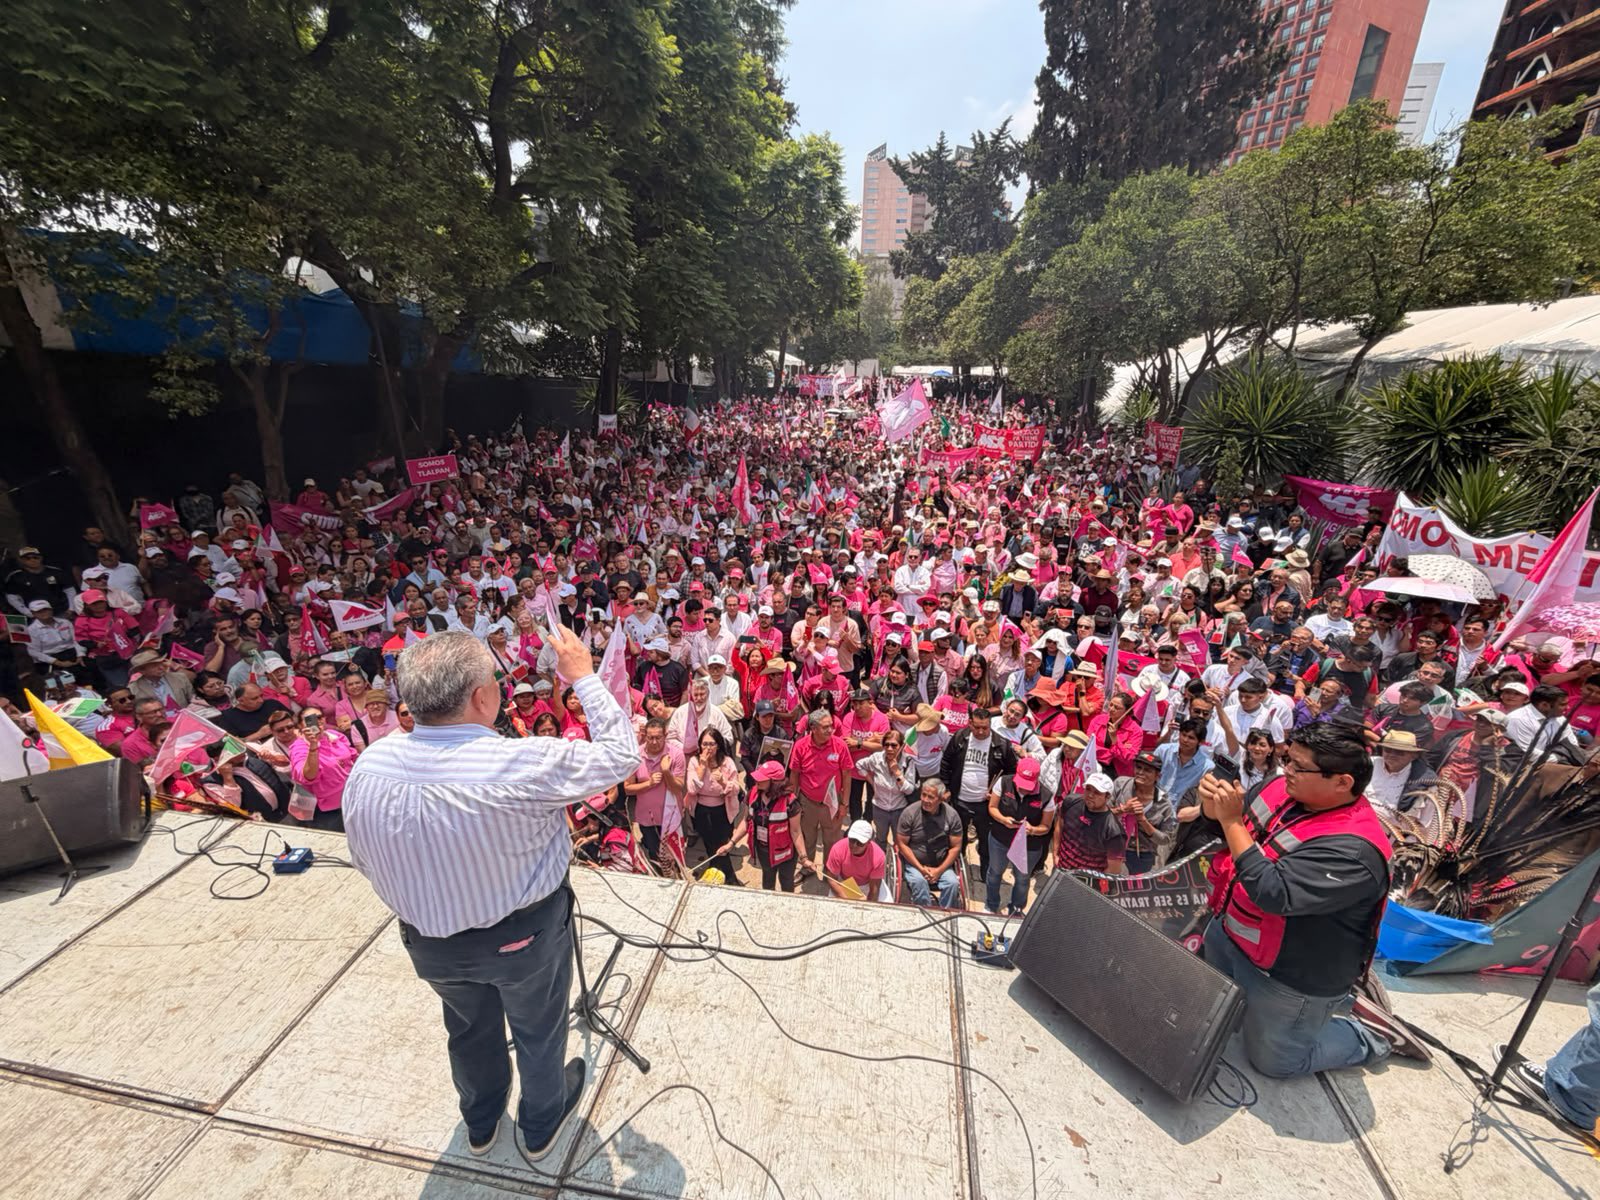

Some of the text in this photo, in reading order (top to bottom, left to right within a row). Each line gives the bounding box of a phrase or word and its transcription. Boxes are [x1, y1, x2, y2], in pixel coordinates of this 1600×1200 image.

[417, 459, 446, 469] SOMOS
[416, 467, 450, 478] TLALPAN
[1325, 486, 1370, 498] SOMOS
[1390, 507, 1462, 559] OMOS
